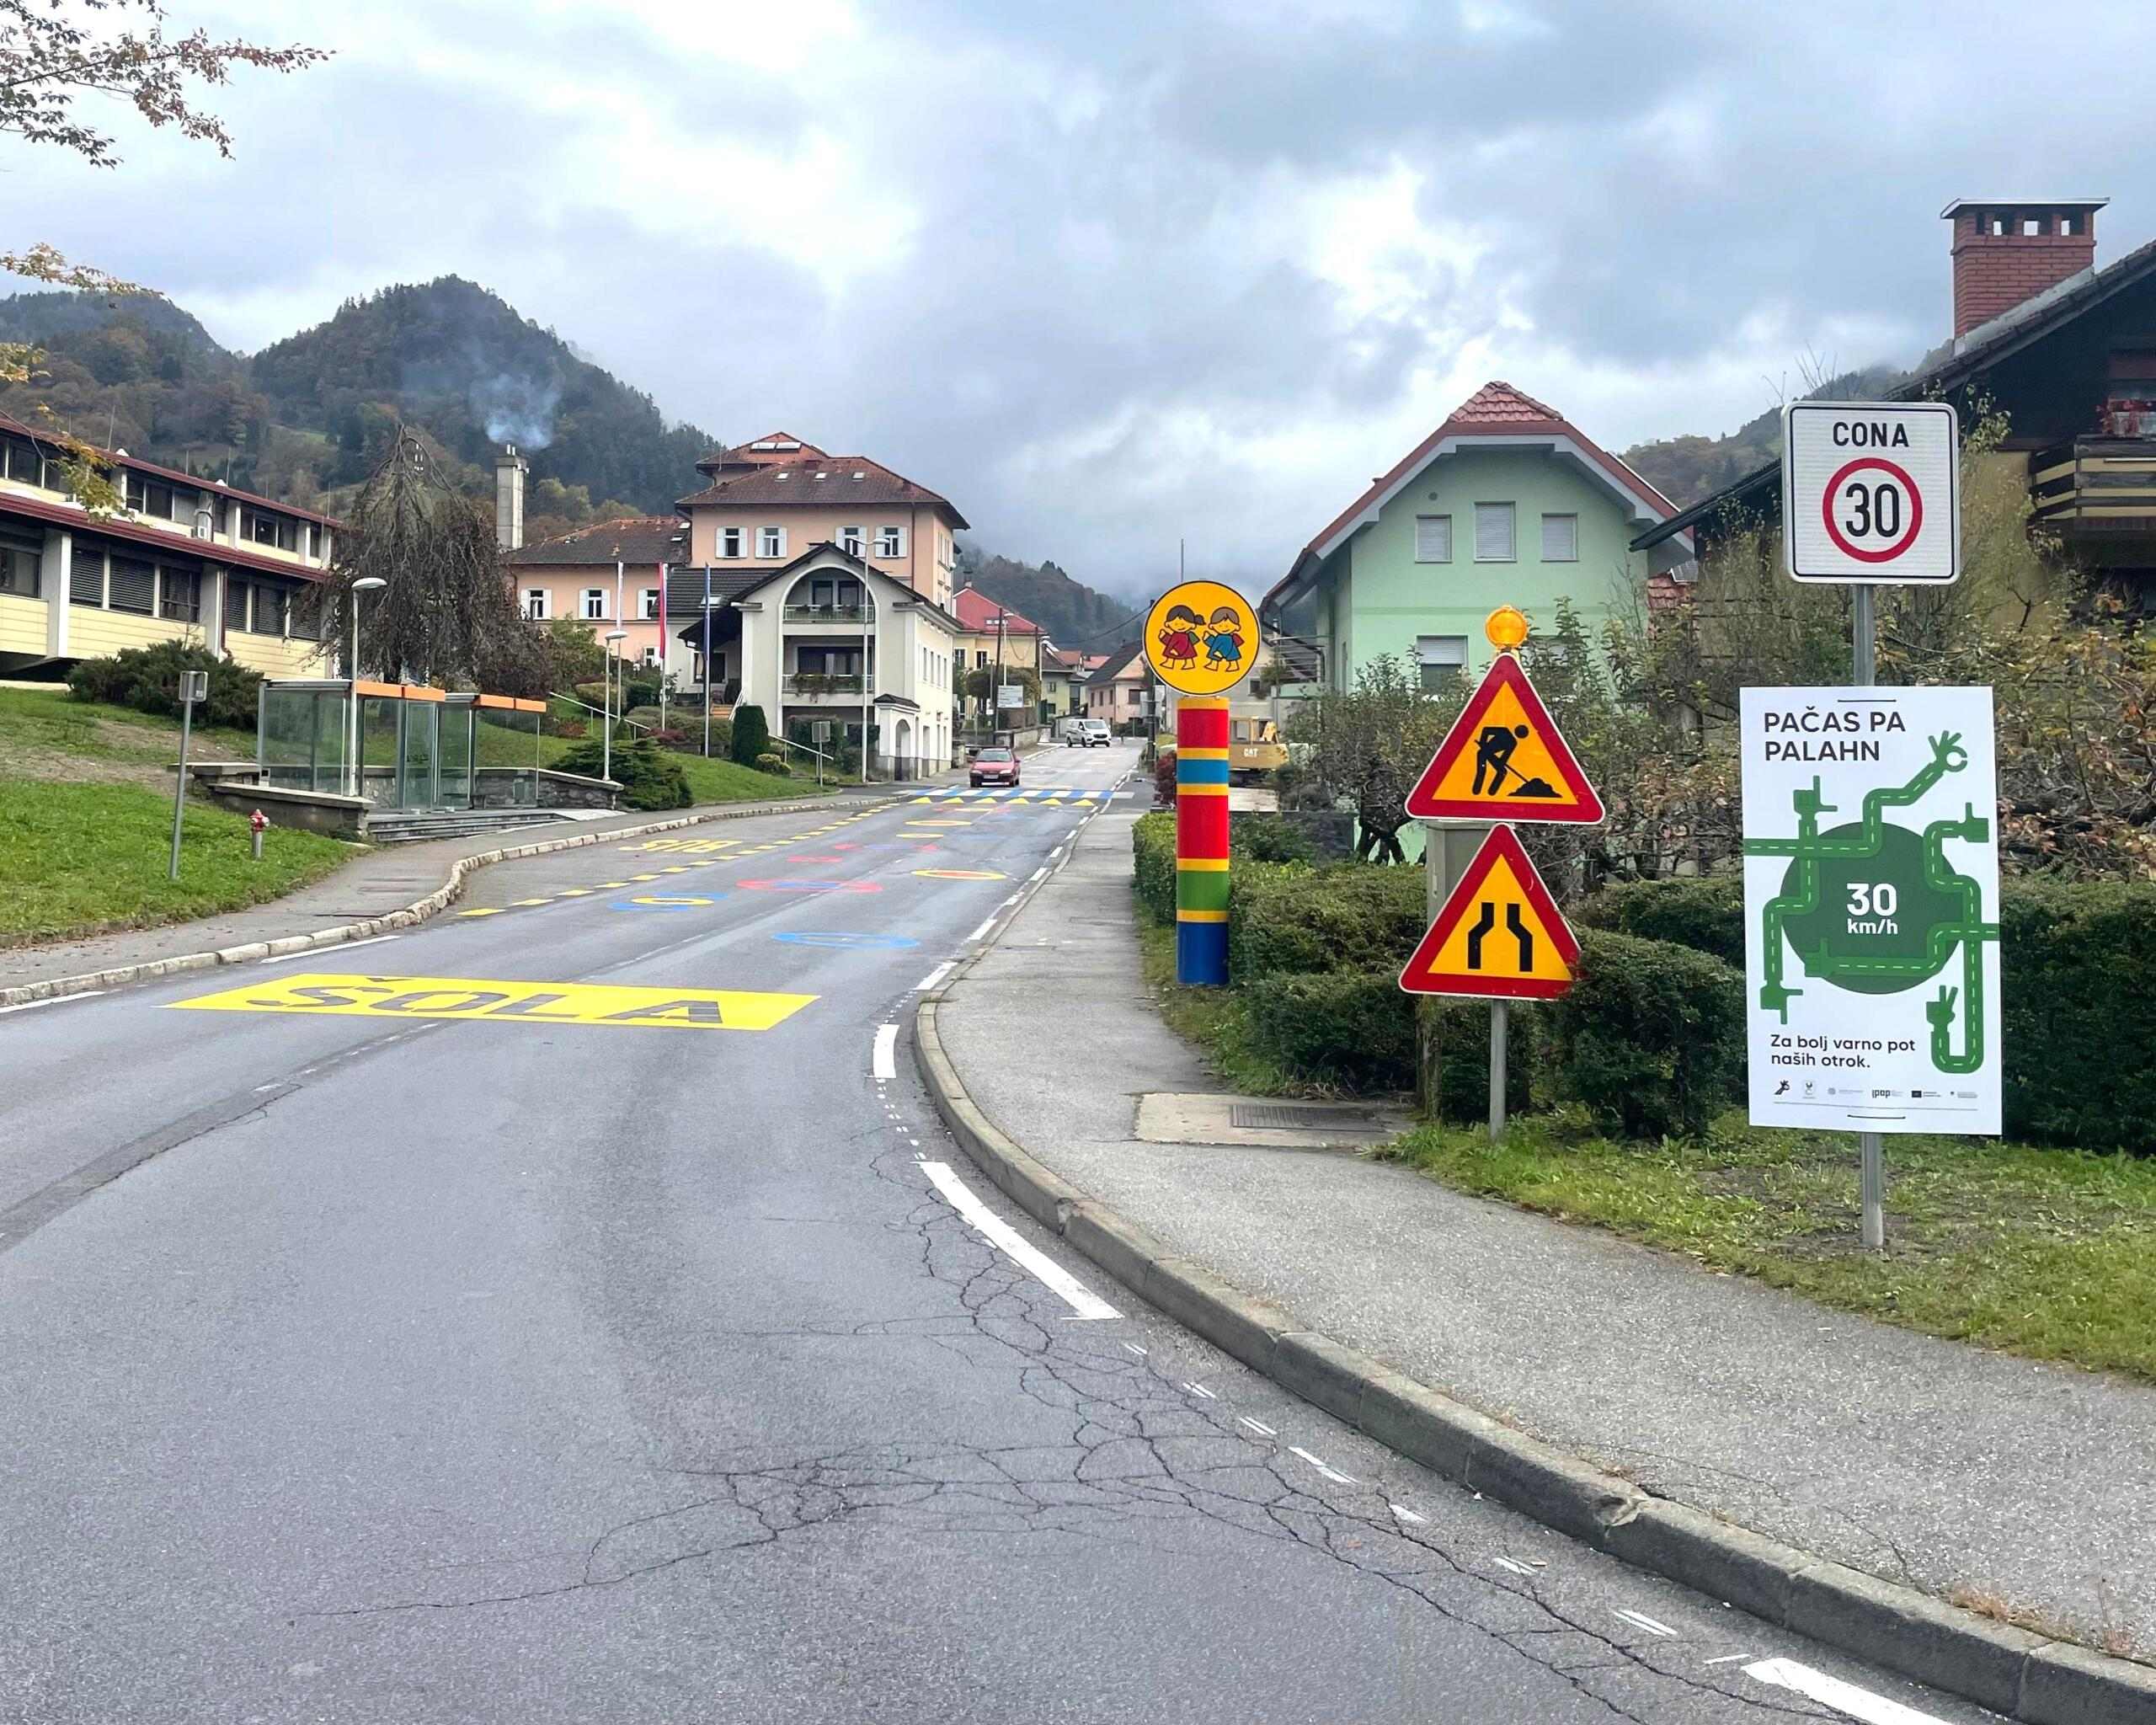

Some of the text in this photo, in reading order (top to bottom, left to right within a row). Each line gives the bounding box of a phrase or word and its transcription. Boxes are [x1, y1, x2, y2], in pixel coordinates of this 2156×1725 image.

[1833, 422, 1909, 447] CONA
[1845, 483, 1900, 537] 30
[1764, 706, 1906, 733] PAČAS PA
[1765, 740, 1880, 761] PALAHN
[1846, 883, 1897, 916] 30
[1847, 919, 1898, 935] km/h
[246, 977, 723, 1024] ŠOLA
[1770, 1034, 1916, 1054] Za bolj varno pot
[1771, 1052, 1870, 1069] naših otrok.
